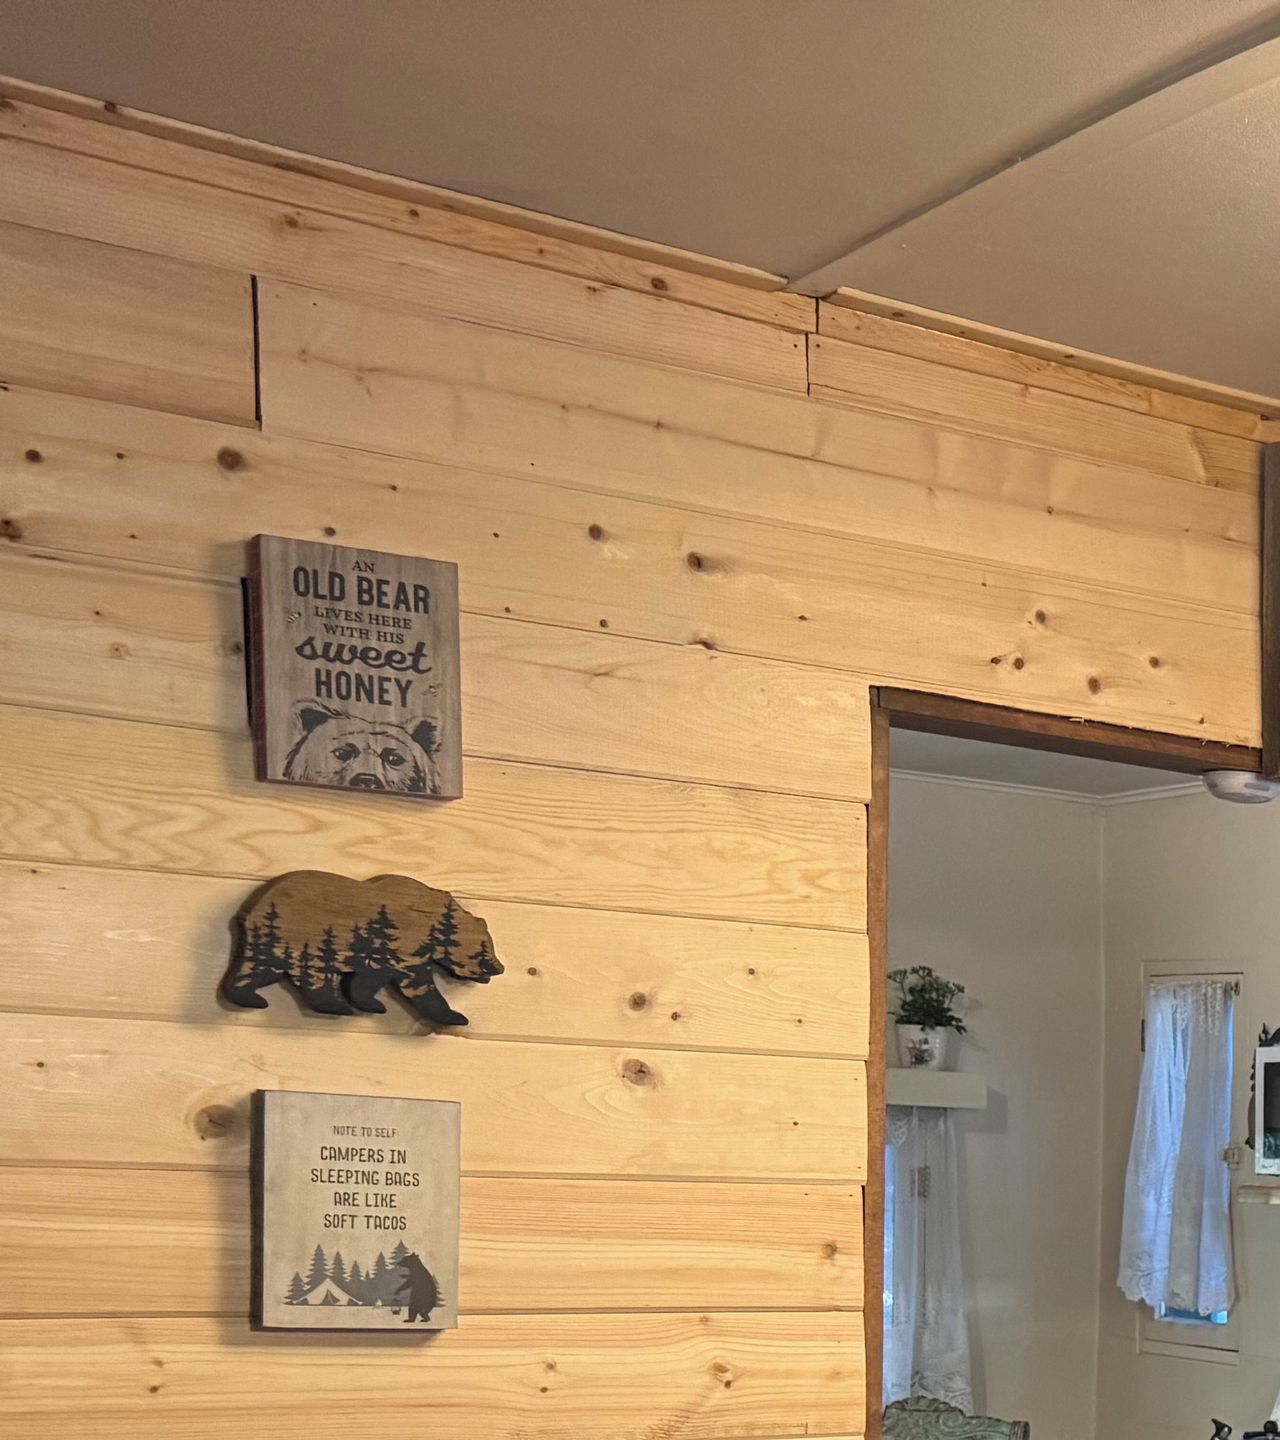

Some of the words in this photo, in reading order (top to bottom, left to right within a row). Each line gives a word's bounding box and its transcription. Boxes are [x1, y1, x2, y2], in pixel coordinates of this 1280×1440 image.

[351, 560, 376, 574] AN
[292, 566, 345, 602] OLD
[357, 576, 431, 615] BEAR
[314, 606, 364, 623] LIVES
[368, 614, 413, 630] HERE
[322, 623, 371, 640] WITH
[376, 631, 405, 644] HIS
[295, 636, 433, 675] sweet
[315, 667, 414, 709] HONEY
[333, 1125, 358, 1137] NOTE
[361, 1126, 373, 1138] TO
[320, 1146, 385, 1164] CAMPERS
[389, 1149, 407, 1164] IN
[311, 1168, 380, 1186] SLEEPING
[385, 1171, 421, 1187] BAGS
[334, 1191, 360, 1208] ARE
[365, 1193, 398, 1209] LIKE
[324, 1213, 359, 1230] SOFT
[364, 1214, 408, 1231] TACOS
